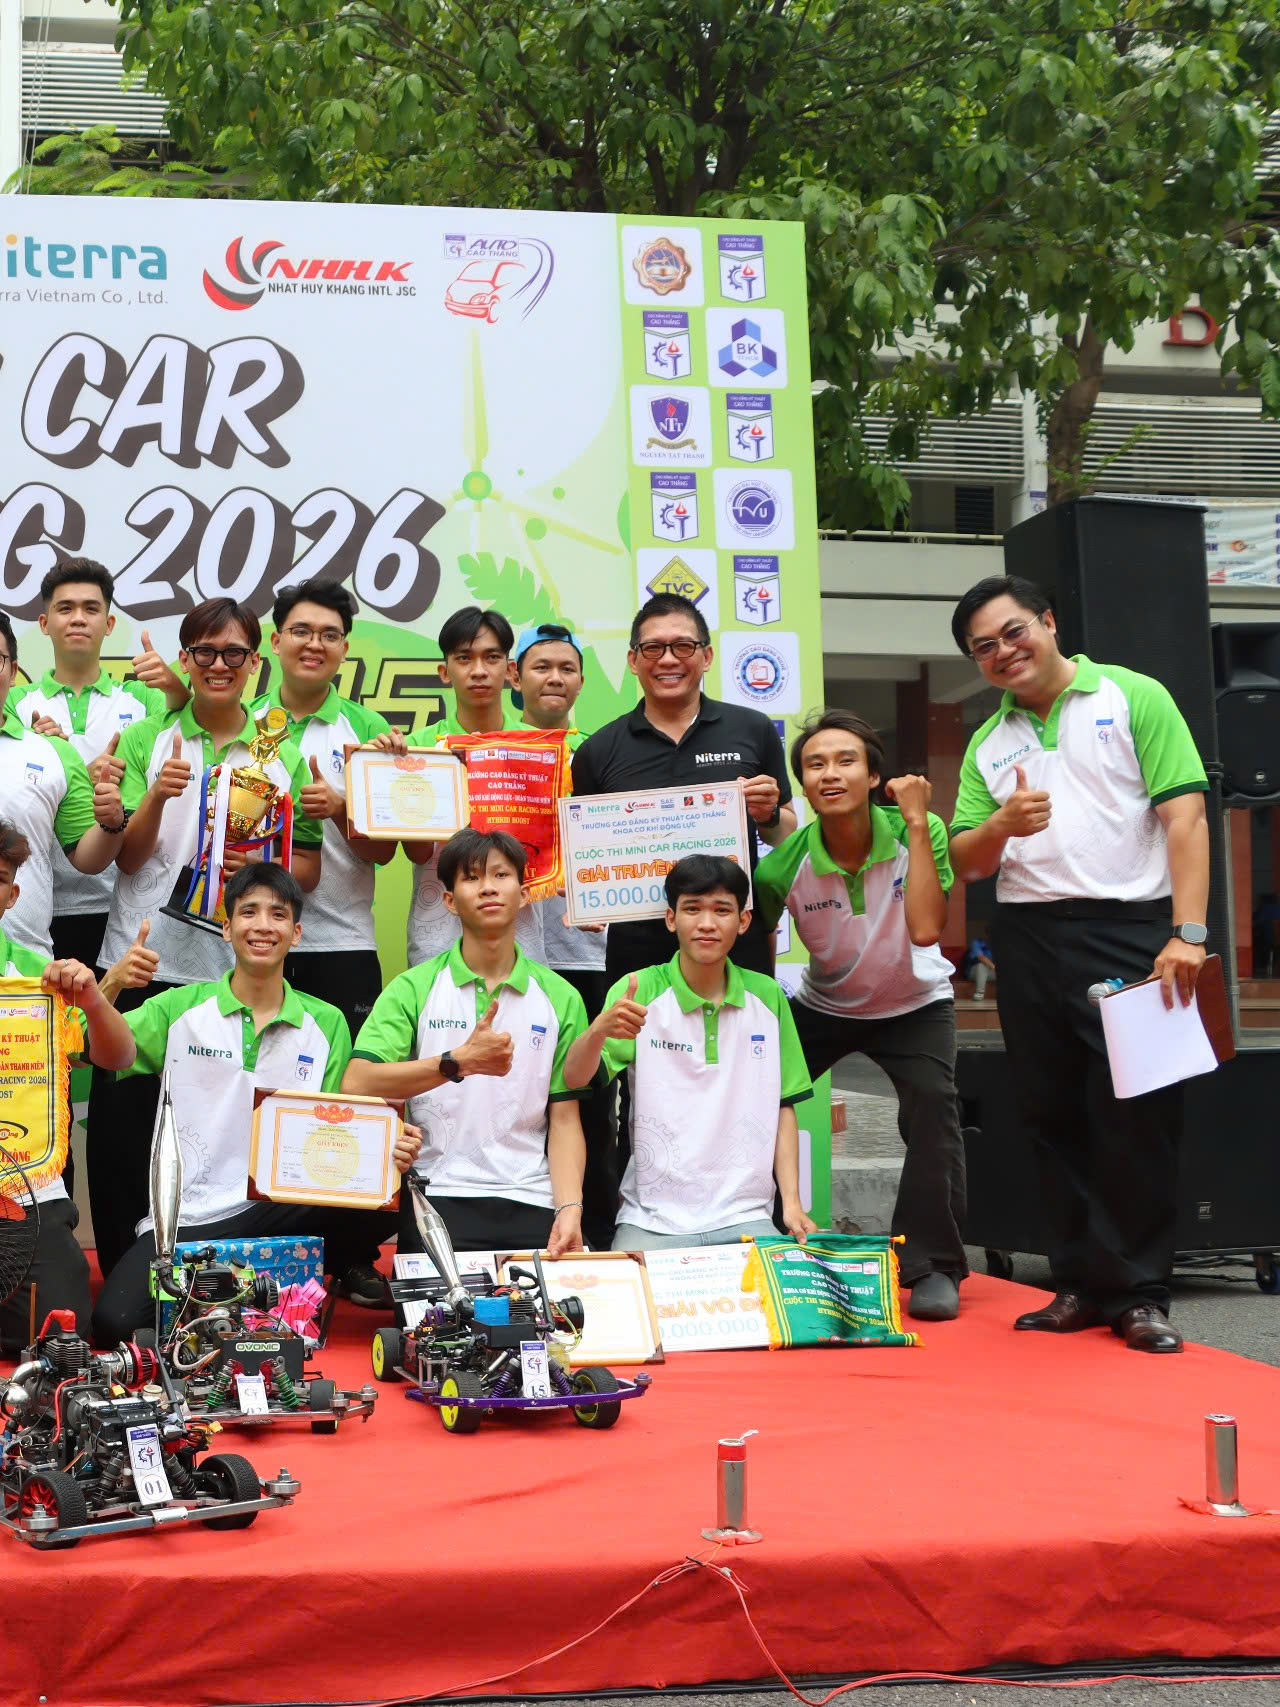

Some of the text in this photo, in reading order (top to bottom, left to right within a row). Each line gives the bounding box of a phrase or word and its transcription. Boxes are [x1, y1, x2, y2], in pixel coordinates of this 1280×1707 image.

[266, 259, 414, 282] NHHK
[26, 289, 96, 303] Vietnam
[138, 290, 168, 304] Ltd.
[268, 283, 416, 297] NHAT HUY KHANG INTL JSC
[736, 343, 758, 355] BK
[21, 331, 304, 468] CAR
[659, 418, 684, 432] NTT
[113, 486, 446, 621] 2026
[660, 582, 696, 594] TVC
[695, 752, 741, 764] Niterra
[992, 744, 1030, 772] Niterra
[588, 804, 620, 814] Niterra
[487, 816, 510, 824] HYBRID
[612, 820, 626, 828] CAO
[686, 813, 701, 821] CAO
[612, 828, 634, 836] KHOA
[574, 836, 737, 860] CUỘC THI MINI CAR RACING 2026
[576, 864, 610, 884] GIẢI
[428, 1019, 467, 1029] Niterra
[2, 1033, 12, 1043] KỸ
[14, 1032, 40, 1044] THUẬT
[188, 1044, 232, 1059] Niterra
[650, 1039, 693, 1052] Niterra
[28, 1076, 47, 1084] 2026
[782, 1268, 810, 1277] TRƯỜNG
[811, 1271, 825, 1280] CAO
[850, 1286, 874, 1296] THUẬT
[811, 1279, 828, 1288] CAO
[784, 1296, 803, 1306] CUỘC
[144, 1480, 162, 1496] 01
